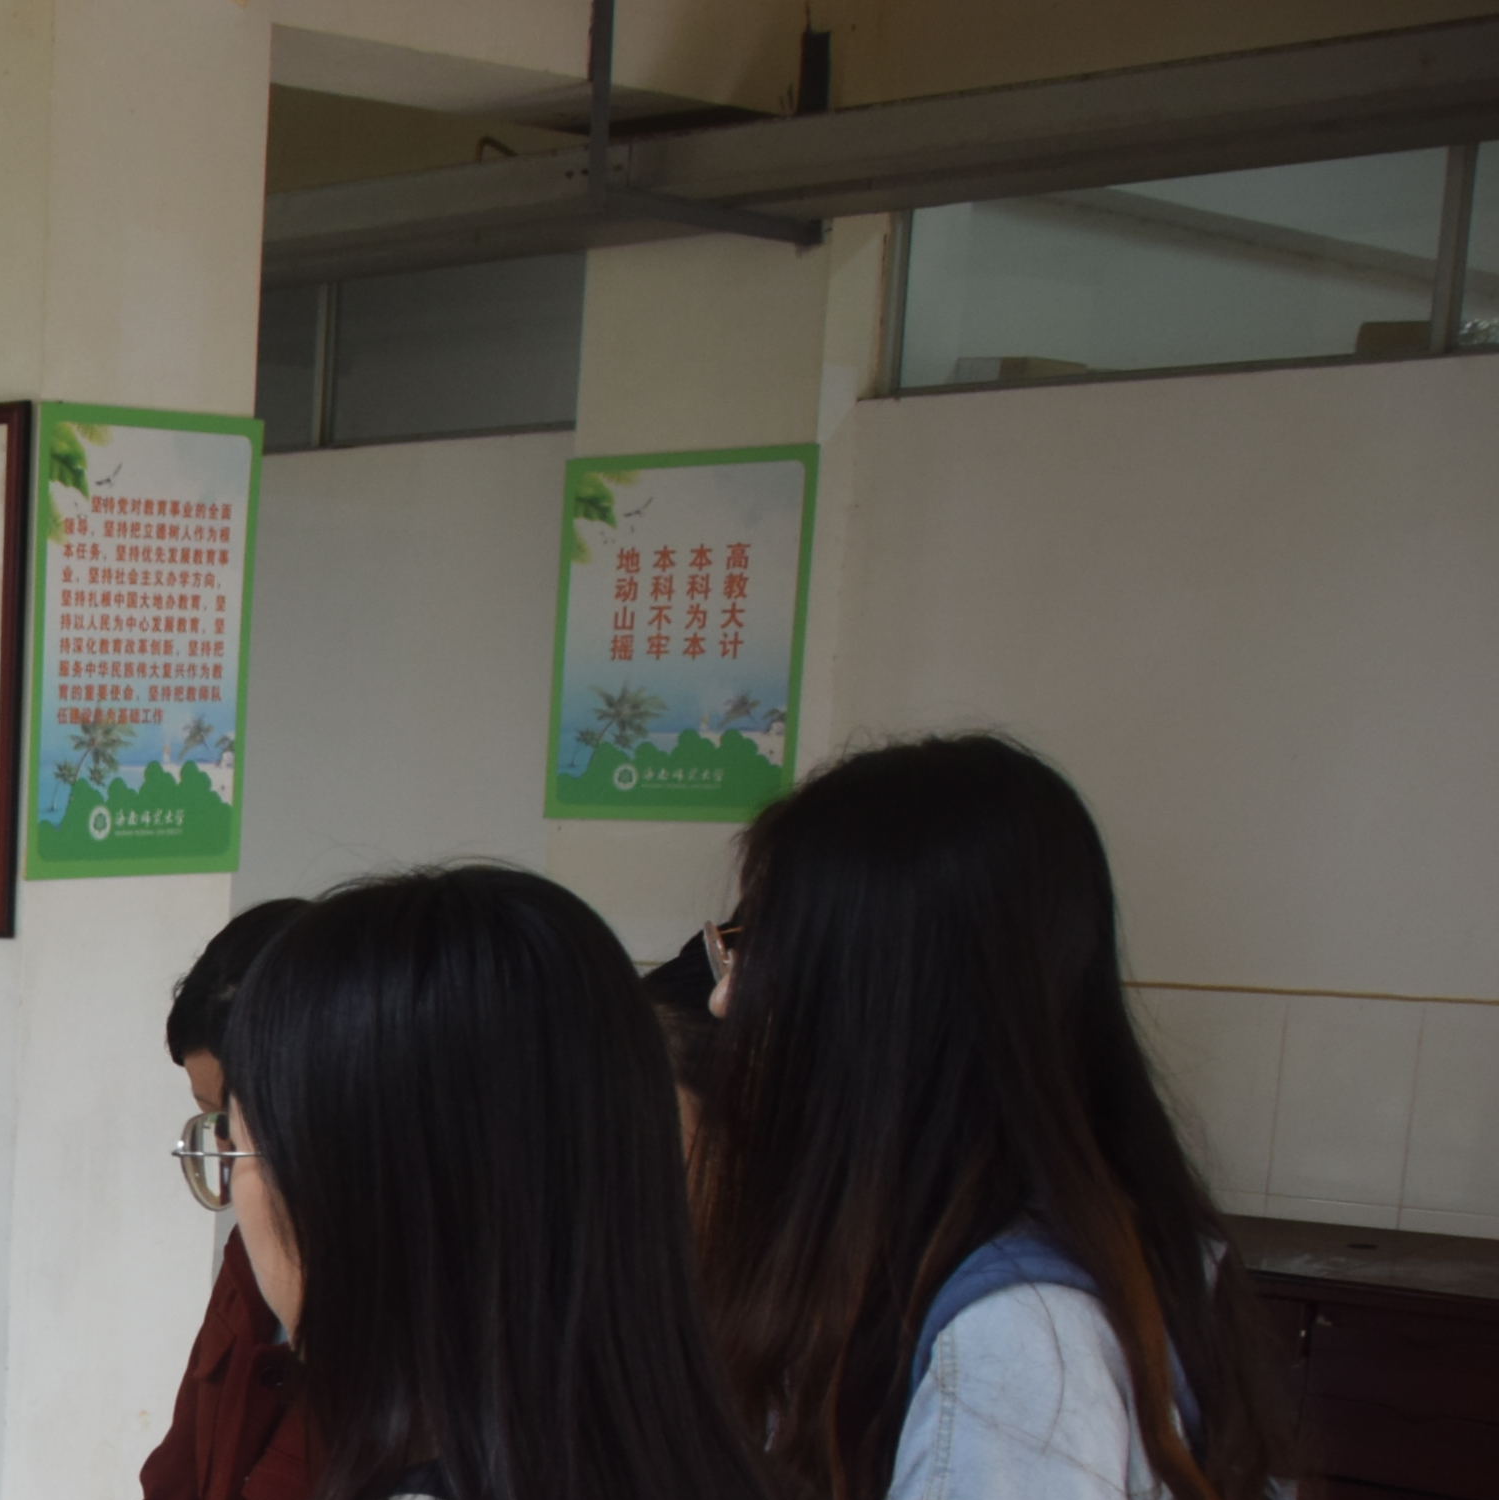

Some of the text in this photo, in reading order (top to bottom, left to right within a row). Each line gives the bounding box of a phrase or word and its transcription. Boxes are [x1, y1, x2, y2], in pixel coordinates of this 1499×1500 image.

[91, 495, 232, 520] 坚持党对教育事业的全面
[610, 547, 641, 661] 地动山摇
[646, 546, 677, 661] 本科不牢
[682, 545, 713, 660] 本科为本
[719, 543, 751, 660] 高教大计
[59, 660, 223, 680] 服务中华民族伟大复兴作为教
